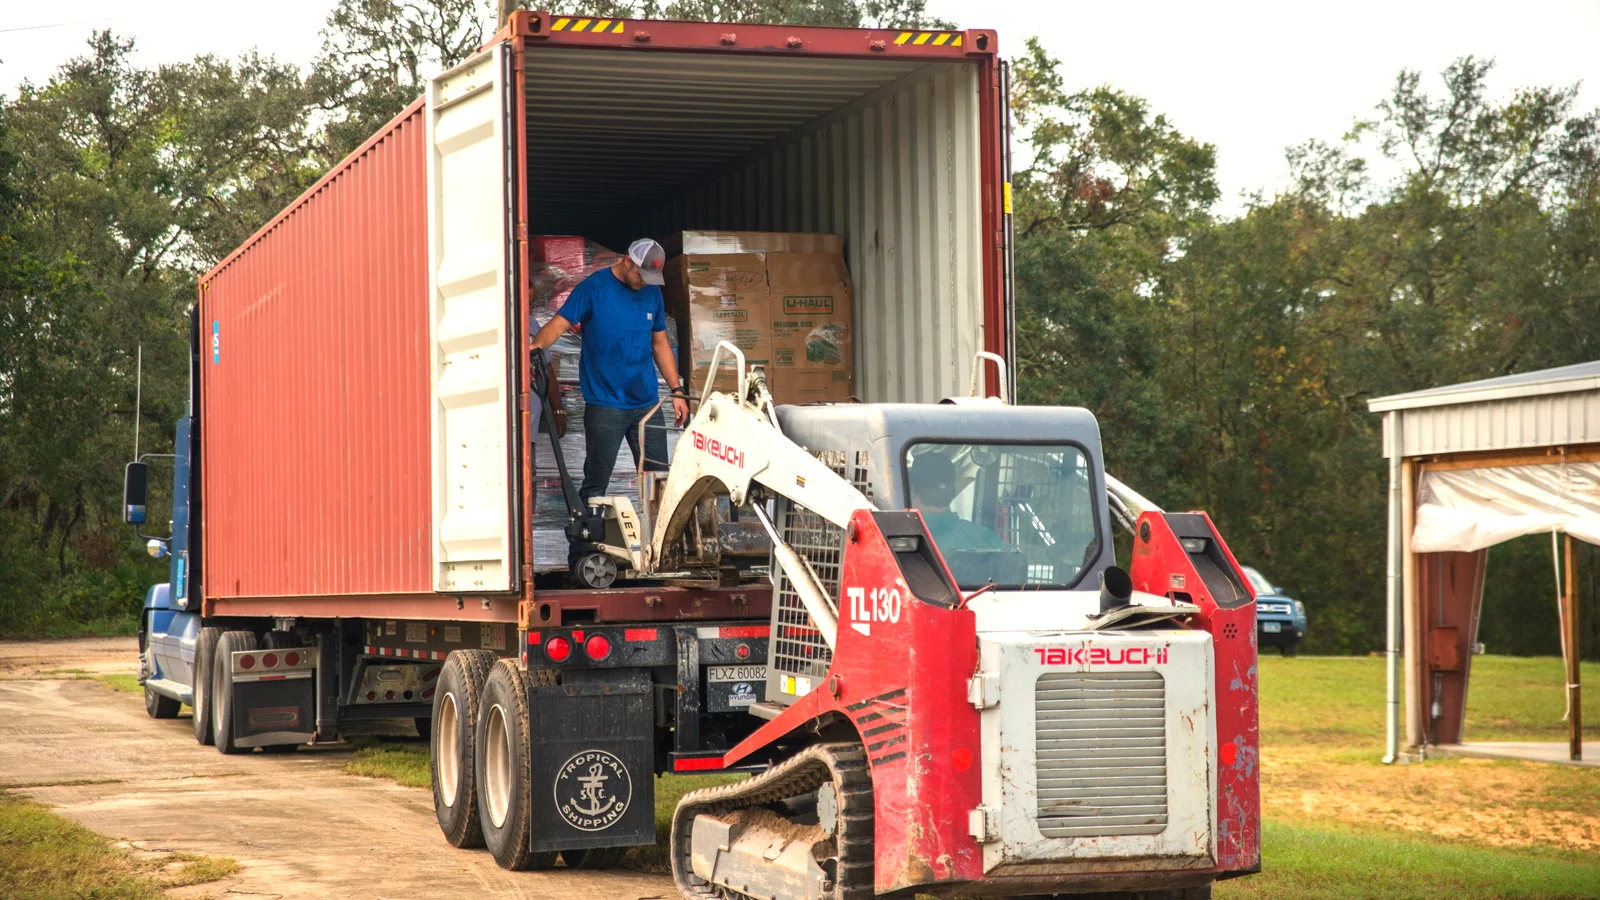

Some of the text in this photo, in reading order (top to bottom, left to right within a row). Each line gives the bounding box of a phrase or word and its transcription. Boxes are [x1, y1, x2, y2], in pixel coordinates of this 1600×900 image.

[785, 299, 831, 308] U-HAUL
[691, 430, 745, 469] TAKEUCHI
[620, 511, 637, 541] JET
[847, 587, 901, 624] TL130
[1034, 647, 1169, 666] TAKEUCHI
[709, 666, 767, 680] FLXZ 60082
[561, 753, 624, 780] TROPICAL
[562, 801, 625, 827] SHIPPING
